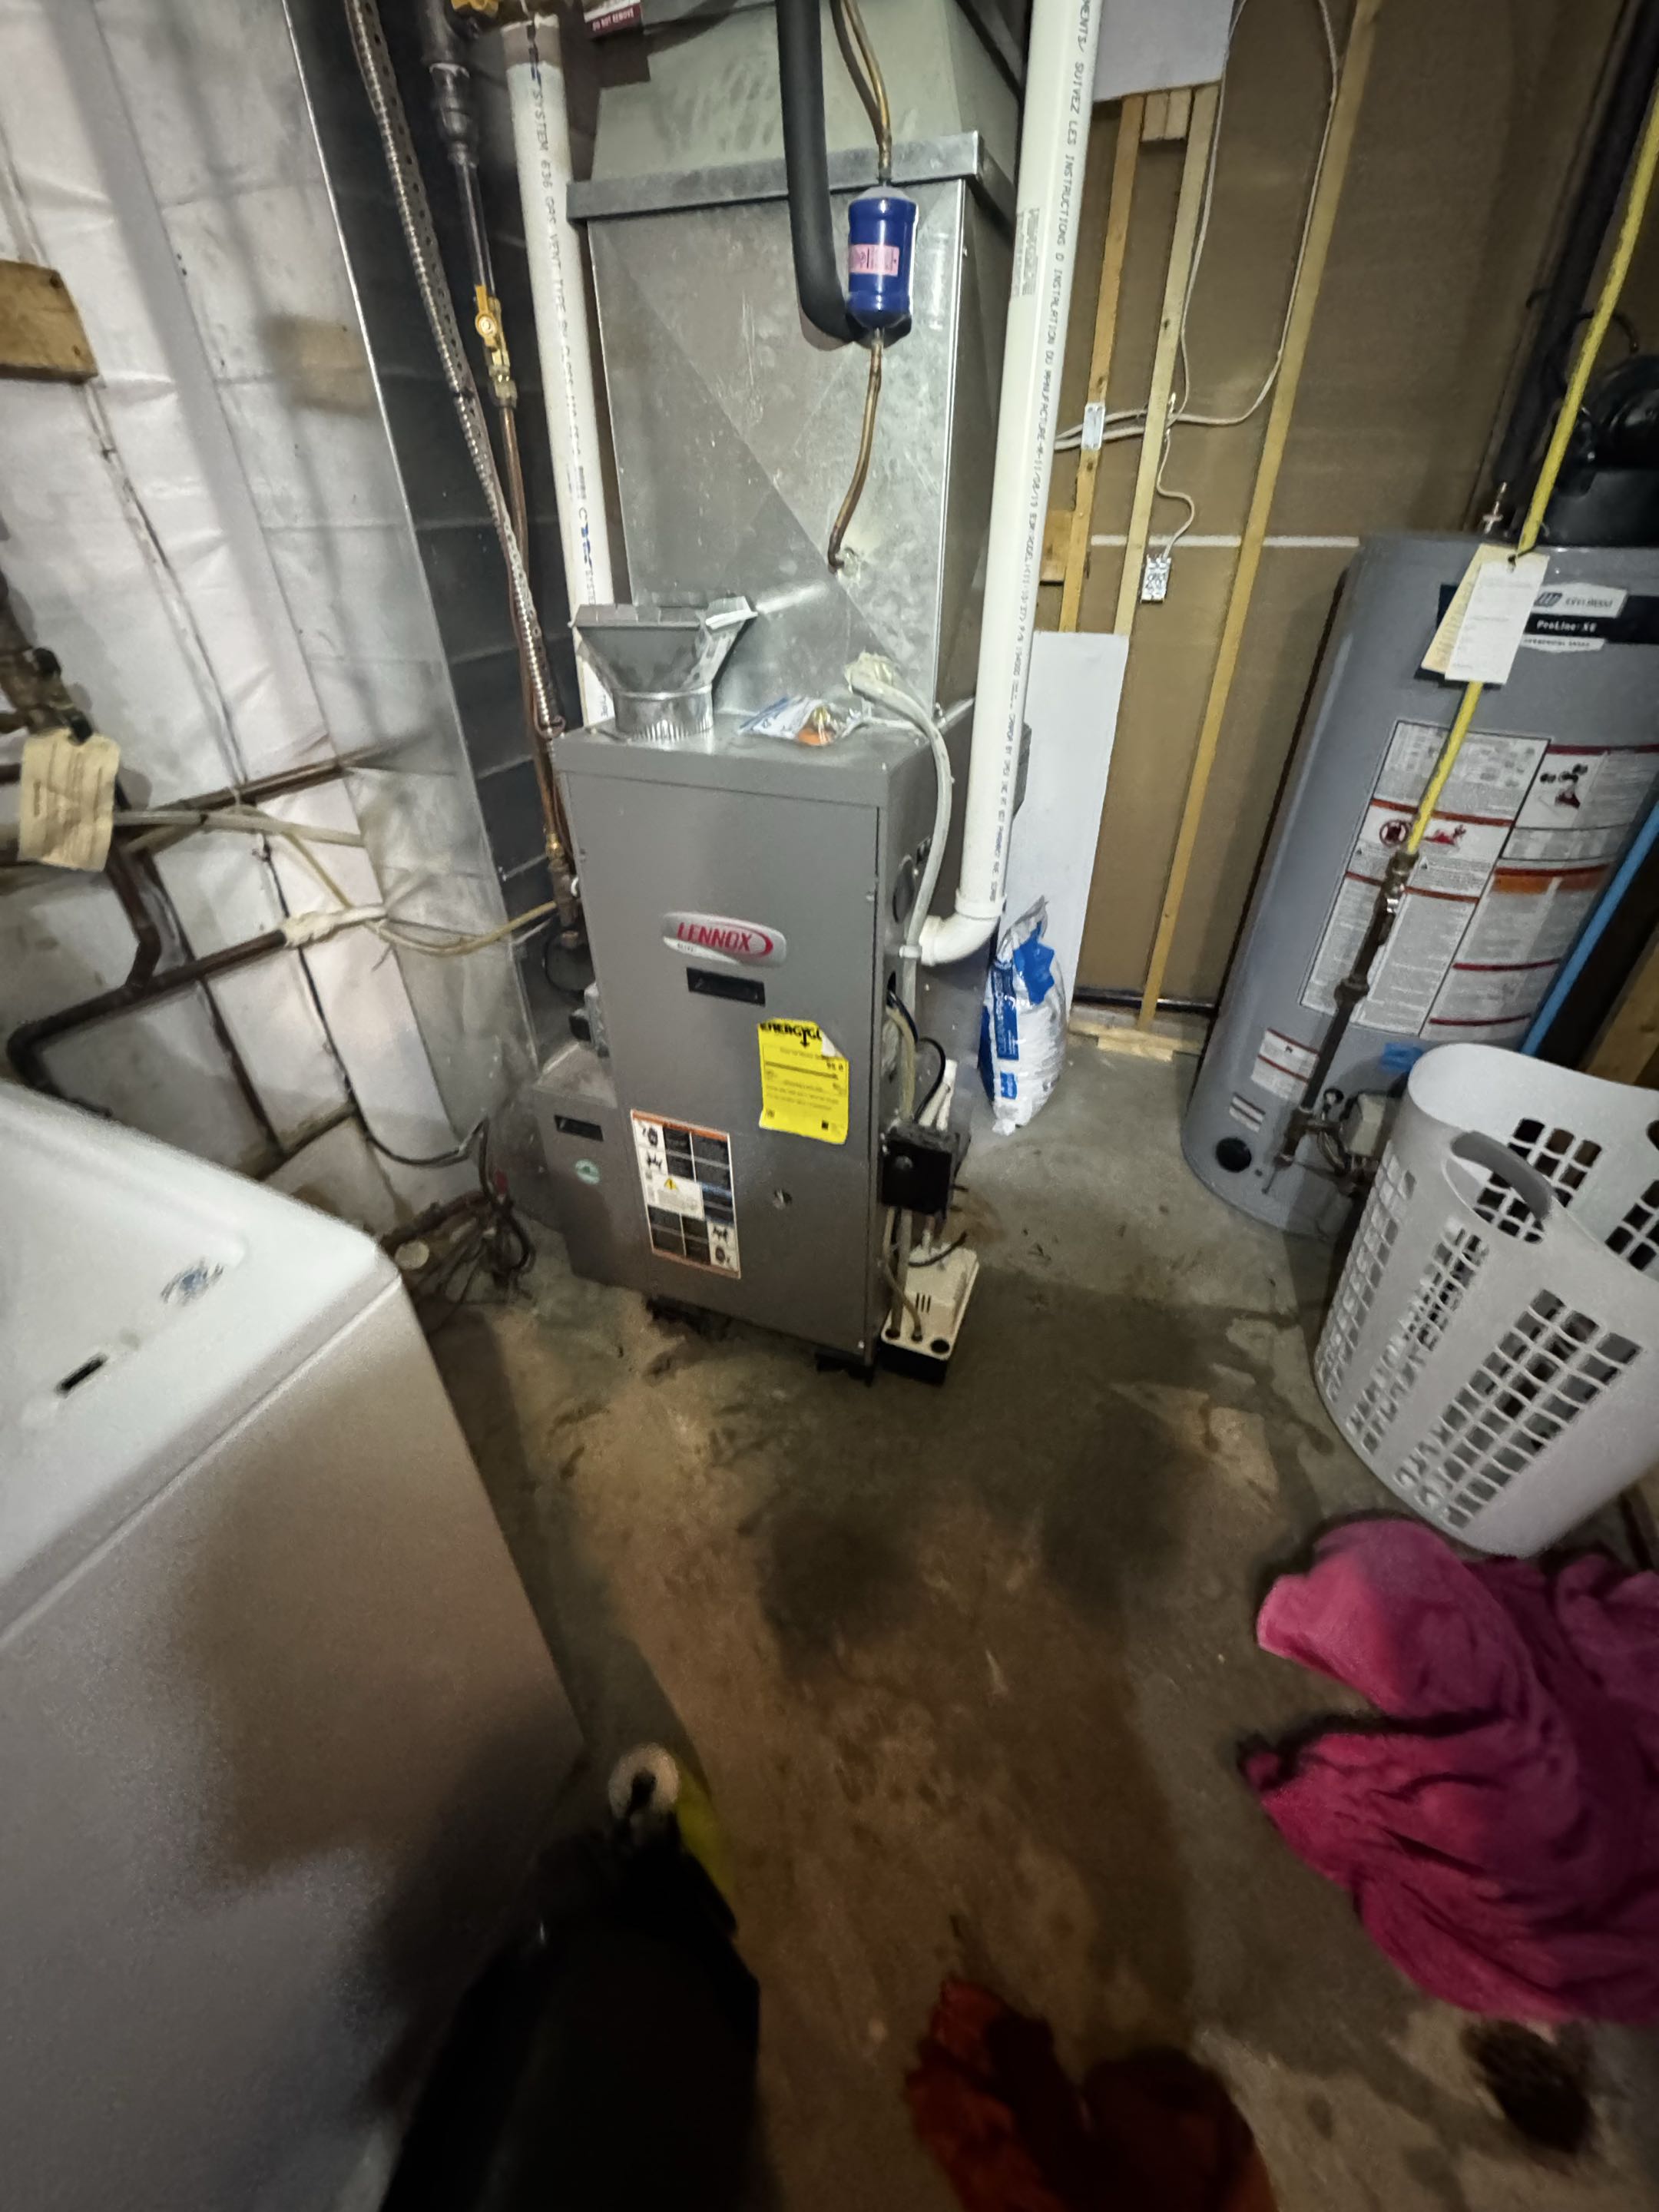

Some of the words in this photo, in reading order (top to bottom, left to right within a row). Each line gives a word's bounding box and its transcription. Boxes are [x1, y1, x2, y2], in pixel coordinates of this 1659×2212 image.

[1070, 62, 1084, 115] SUIVEZ
[532, 88, 549, 151] SYSTEM
[1067, 121, 1078, 145] LES
[540, 160, 553, 189] 636
[677, 922, 752, 952] LENNOX
